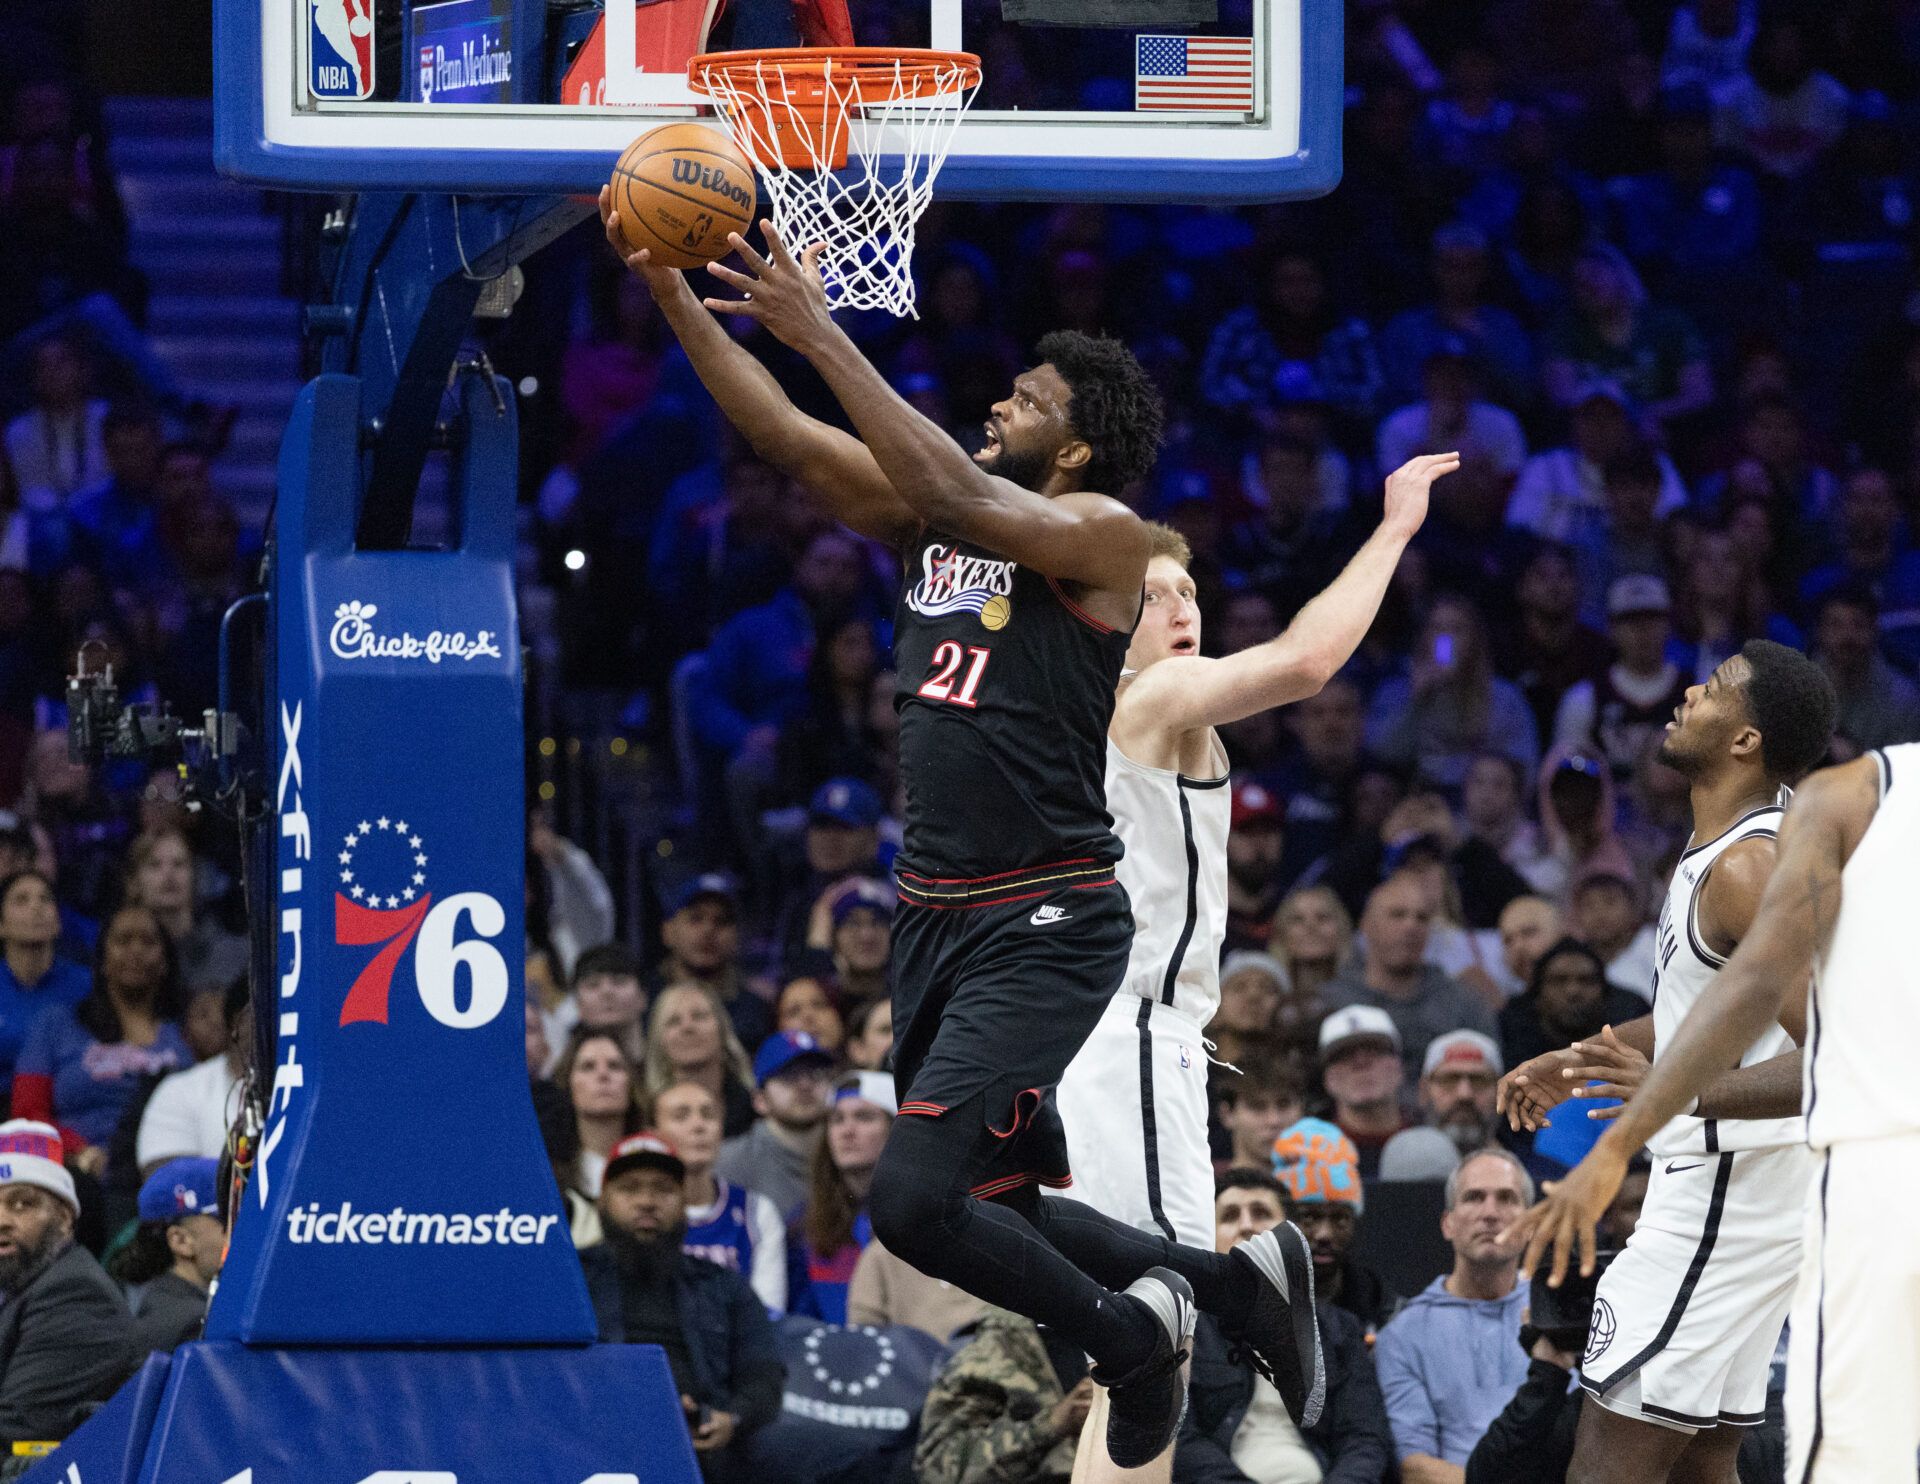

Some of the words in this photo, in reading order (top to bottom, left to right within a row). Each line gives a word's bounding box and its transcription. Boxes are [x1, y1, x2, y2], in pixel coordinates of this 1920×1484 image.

[318, 66, 349, 90] NBA
[435, 45, 463, 92] Penn
[463, 34, 511, 88] Medicine
[672, 158, 752, 211] Wilson
[906, 544, 1017, 608] SIXERS
[330, 600, 501, 663] Chick-fil-A
[917, 640, 991, 708] 21
[1037, 904, 1066, 918] NIKE
[257, 699, 311, 1210] xfinity
[335, 891, 509, 1029] 76
[287, 1202, 557, 1245] ticketmaster
